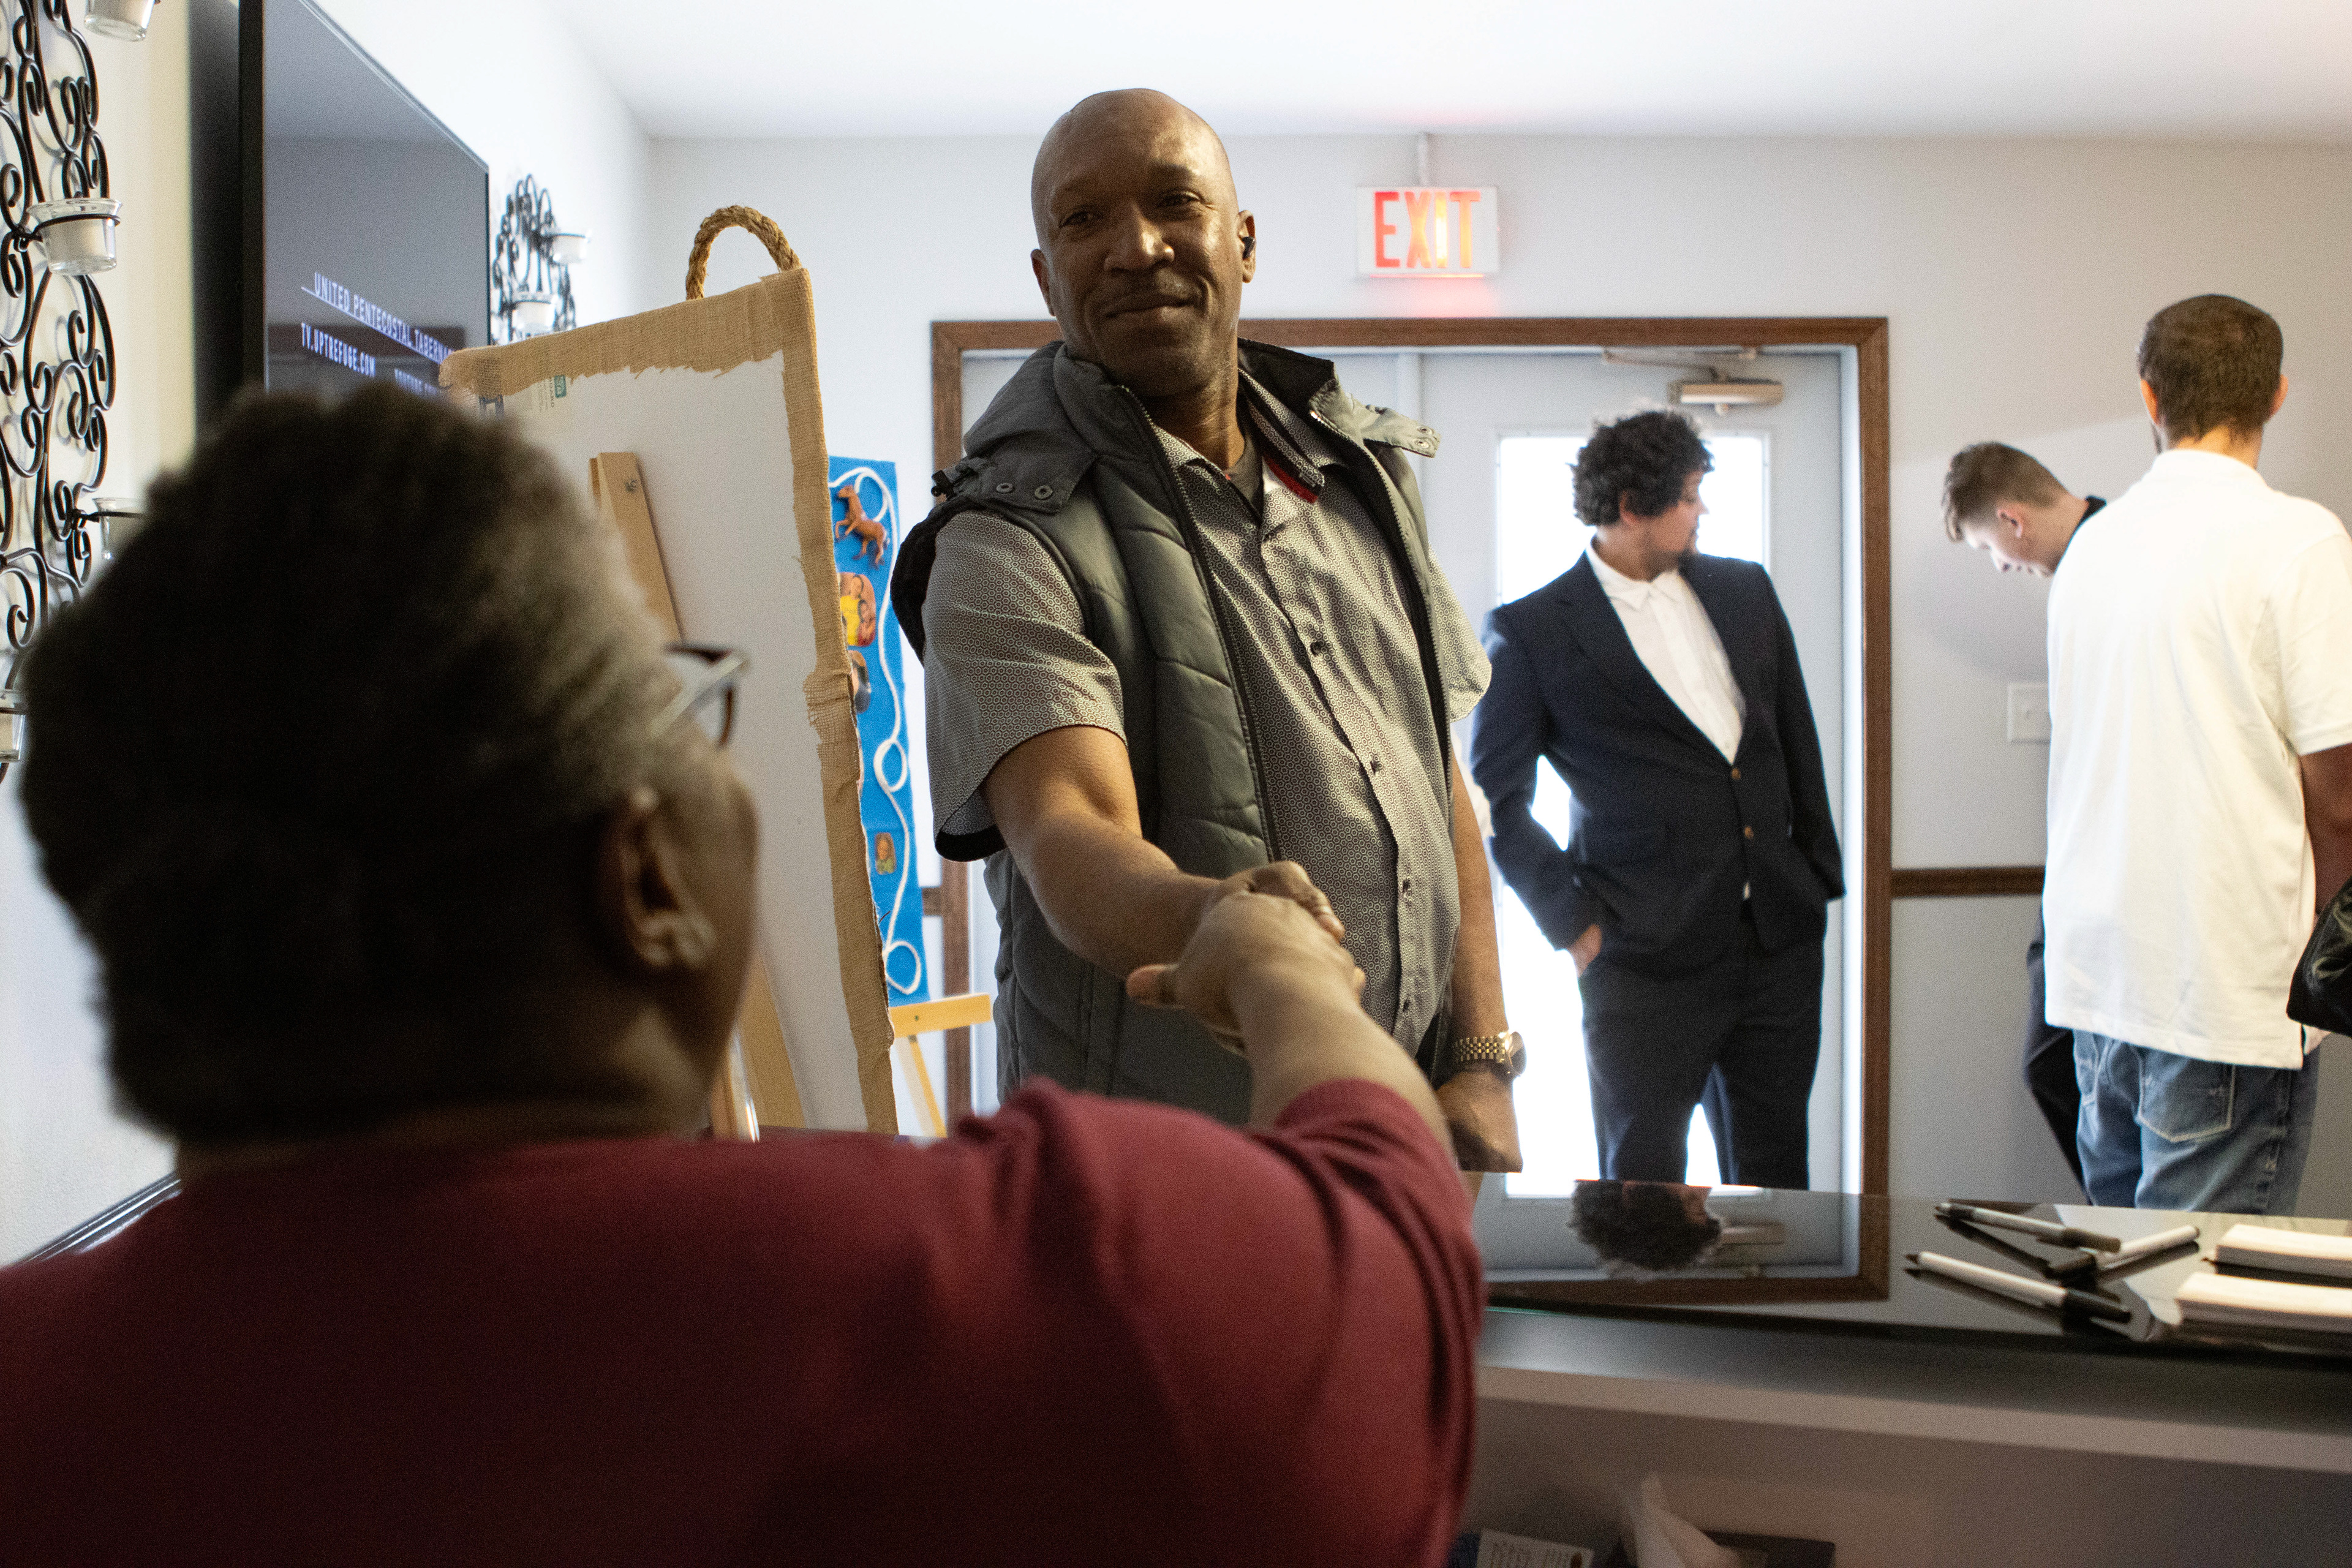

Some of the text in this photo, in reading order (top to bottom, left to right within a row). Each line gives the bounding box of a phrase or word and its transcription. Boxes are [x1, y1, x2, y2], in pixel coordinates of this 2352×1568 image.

[1374, 190, 1481, 268] EXIT
[314, 272, 350, 313] UNITED
[353, 294, 413, 349] PENTECOSTAL
[301, 322, 375, 377] TV.UPTREFUGE.COM
